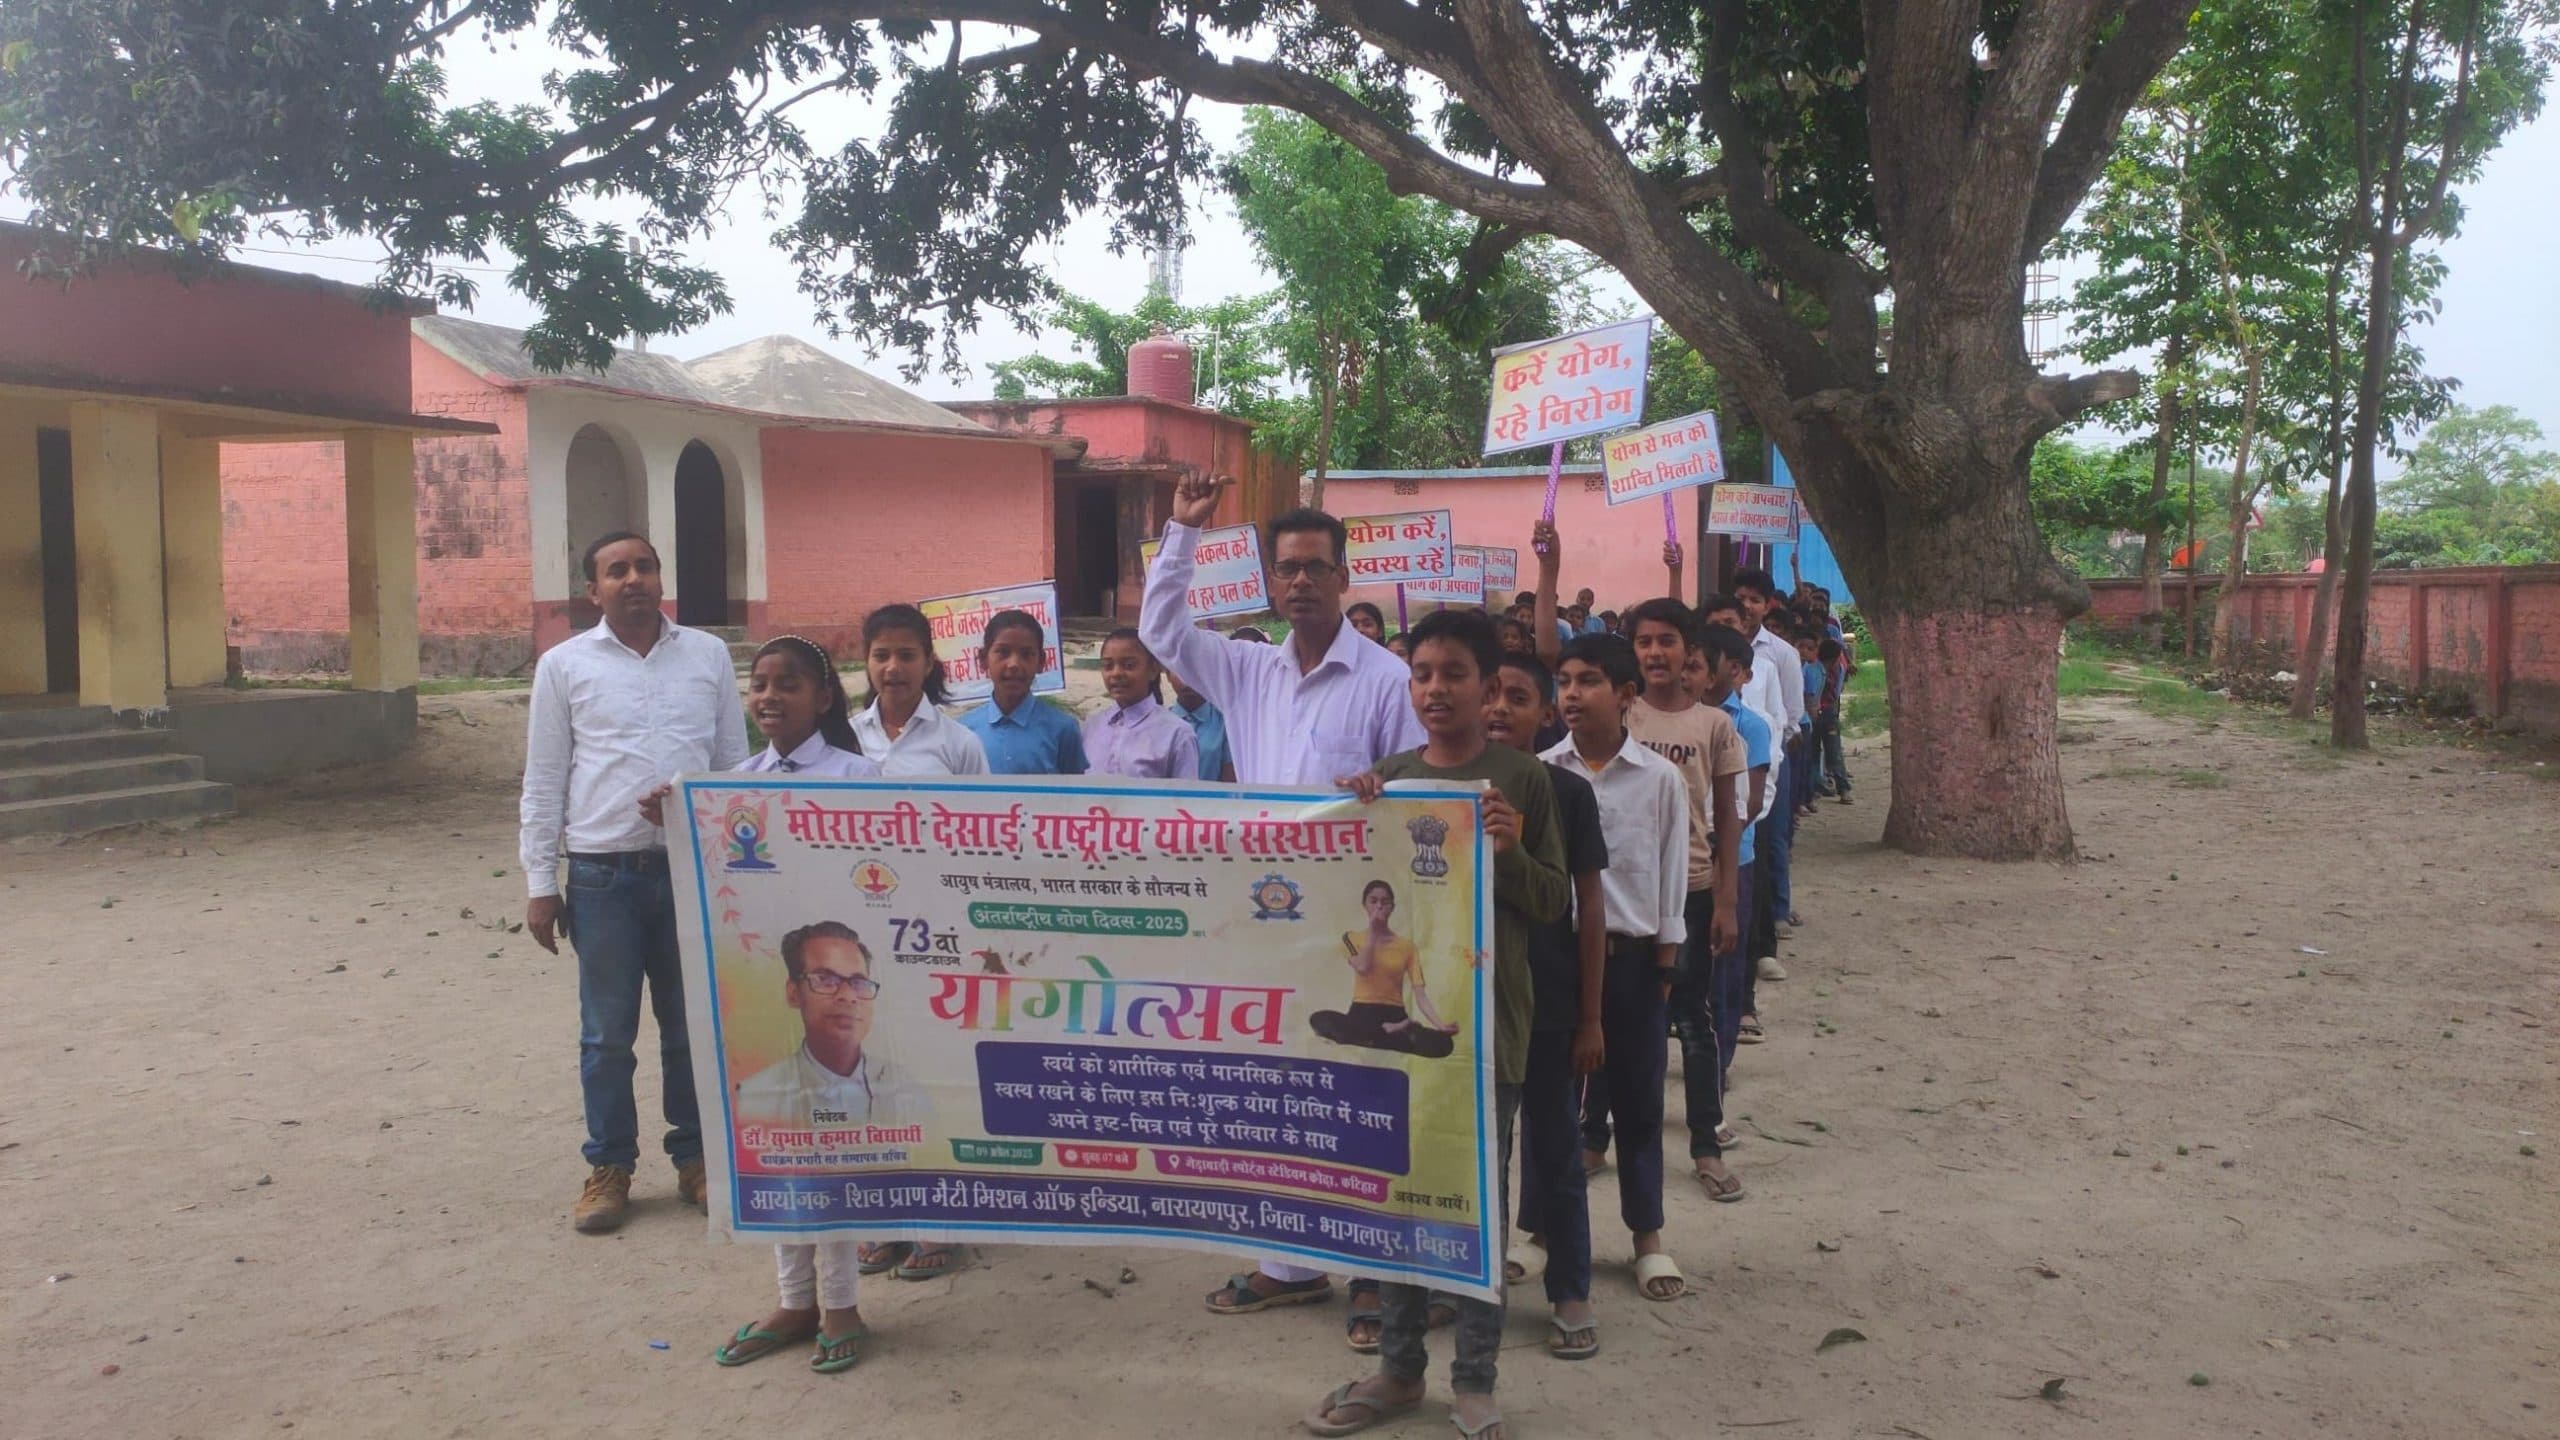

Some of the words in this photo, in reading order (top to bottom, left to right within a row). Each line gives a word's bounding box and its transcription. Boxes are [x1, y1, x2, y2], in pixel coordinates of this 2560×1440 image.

[1503, 350, 1549, 392] करें
[1557, 341, 1632, 378] योग,
[1494, 404, 1531, 441] रहे
[1537, 386, 1636, 432] निरोग
[1611, 441, 1640, 461] योग
[1643, 435, 1657, 453] से
[1661, 429, 1684, 449] मन
[1688, 420, 1708, 441] को
[1656, 454, 1704, 483] मिलती
[1707, 449, 1719, 474] है
[1231, 530, 1255, 560] करें,
[1349, 520, 1396, 543] योग
[1402, 515, 1447, 541] करें,
[1351, 555, 1411, 574] स्वस्थ
[1416, 547, 1445, 574] रहें
[1199, 587, 1217, 611] हर
[1218, 583, 1239, 603] पल
[1240, 571, 1262, 600] करें
[954, 650, 972, 681] करें
[785, 800, 922, 845] मोरारजी
[932, 802, 1023, 853] देसाई
[1032, 806, 1144, 863] राष्ट्रीय
[1154, 809, 1229, 854] योग
[1240, 810, 1368, 855] संस्थान
[940, 874, 979, 895] आयुष
[983, 872, 1038, 895] मंत्रालय,
[1041, 878, 1076, 894] भारत
[1079, 879, 1122, 896] सरकार
[1127, 875, 1140, 896] के
[1144, 875, 1190, 897] सौजन्य
[1194, 877, 1208, 898] से
[1056, 908, 1088, 927] योग
[889, 918, 931, 953] 73
[932, 926, 960, 954] वां
[929, 950, 1296, 1044] योगोत्सव
[1042, 1052, 1075, 1073] स्वयं
[1080, 1052, 1103, 1074] को
[1109, 1054, 1177, 1078] शारीरिक
[1182, 1059, 1206, 1081] एवं
[1212, 1061, 1283, 1085] मानसिक
[1288, 1069, 1314, 1088] रूप
[1319, 1068, 1334, 1089] से
[813, 1109, 848, 1123] निवेदक
[994, 1082, 1033, 1099] स्वस्थ
[1038, 1080, 1074, 1101] रखने
[1080, 1081, 1096, 1103] के
[1101, 1082, 1135, 1106] लिए
[1139, 1090, 1164, 1107] इस
[1244, 1092, 1278, 1114] योग
[1283, 1094, 1333, 1120] शिविर
[1337, 1101, 1351, 1123] में
[1358, 1111, 1393, 1131] आप
[744, 1128, 766, 1146] डॉ.
[771, 1131, 814, 1151] सुभाष
[819, 1129, 862, 1151] कुमार
[1048, 1109, 1088, 1129] अपने
[1168, 1116, 1192, 1138] एवं
[1197, 1118, 1218, 1144] पूरे
[1223, 1120, 1278, 1143] परिवार
[1283, 1124, 1300, 1145] के
[1304, 1131, 1338, 1151] साथ
[845, 1182, 883, 1208] शिव
[889, 1187, 928, 1208] प्राण
[932, 1177, 968, 1208] मैटी
[973, 1181, 1028, 1209] मिशन
[1032, 1184, 1076, 1211] ऑफ
[1079, 1187, 1147, 1218] इन्डिया,
[1151, 1197, 1254, 1231] नारायणपुर,
[1319, 1216, 1410, 1256] भागलपुर,
[1415, 1226, 1469, 1261] बिहार
